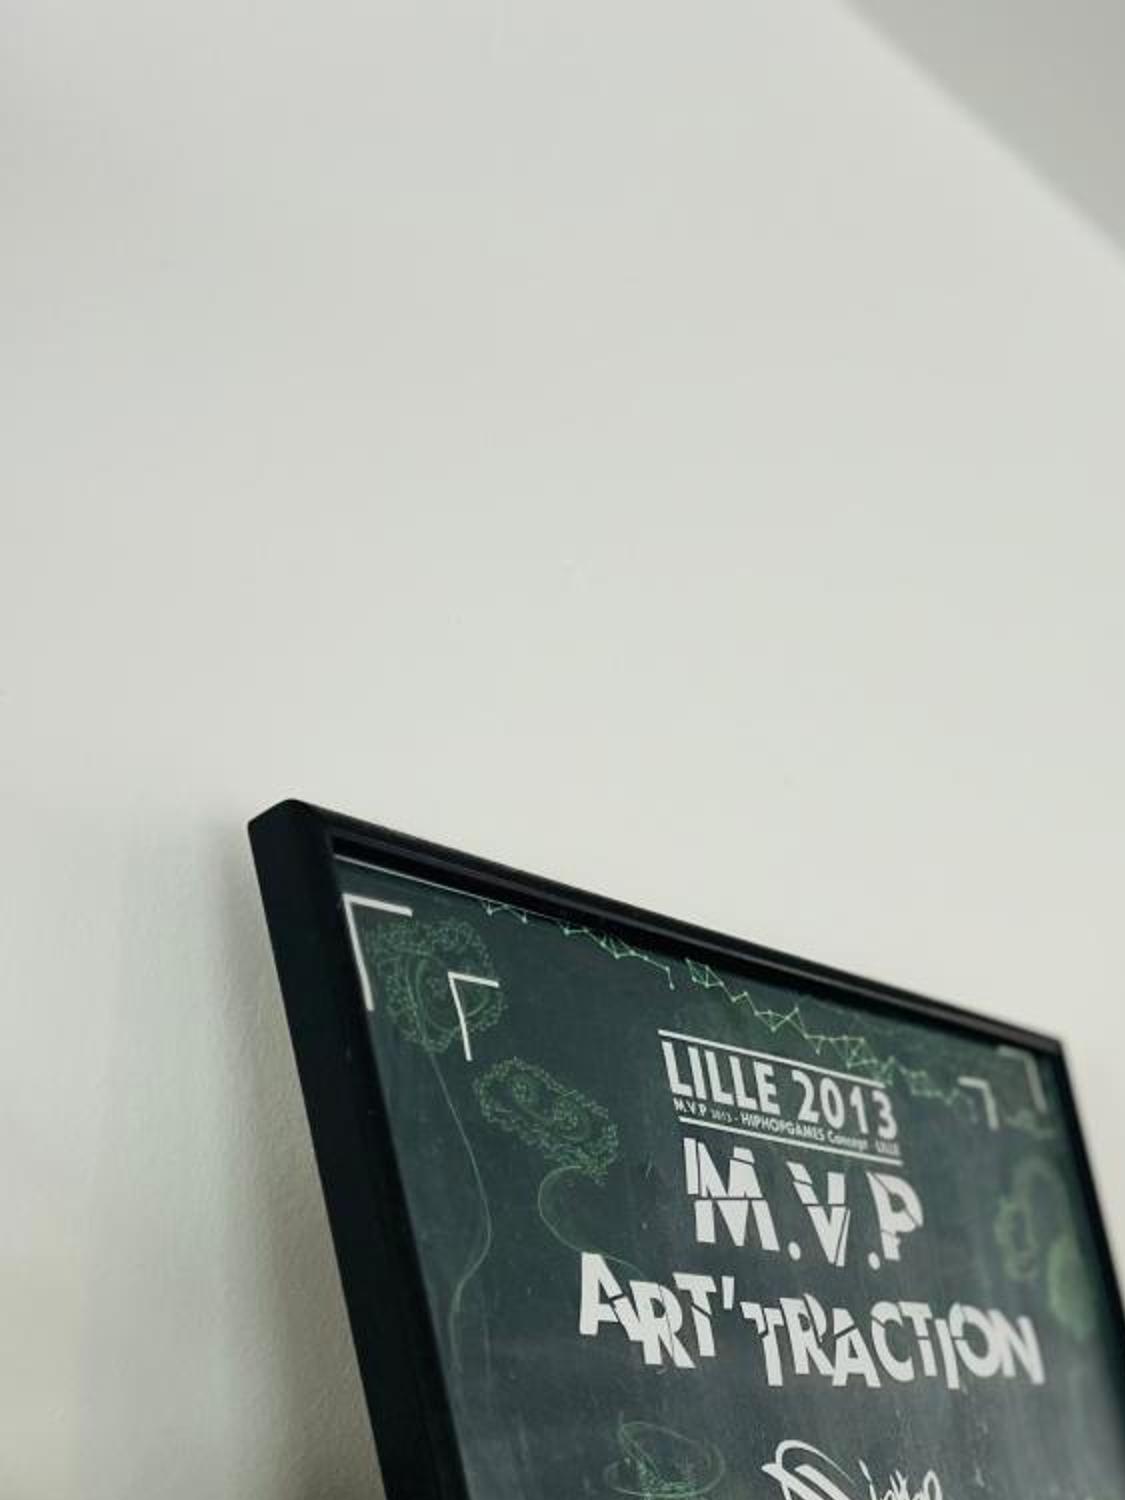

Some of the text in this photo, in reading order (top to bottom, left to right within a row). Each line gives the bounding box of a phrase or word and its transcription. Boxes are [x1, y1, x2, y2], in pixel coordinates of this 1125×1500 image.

[661, 1040, 899, 1140] LILLE 2013
[740, 1111, 825, 1141] HIPHOPGAMES
[683, 1137, 924, 1270] M.V.P
